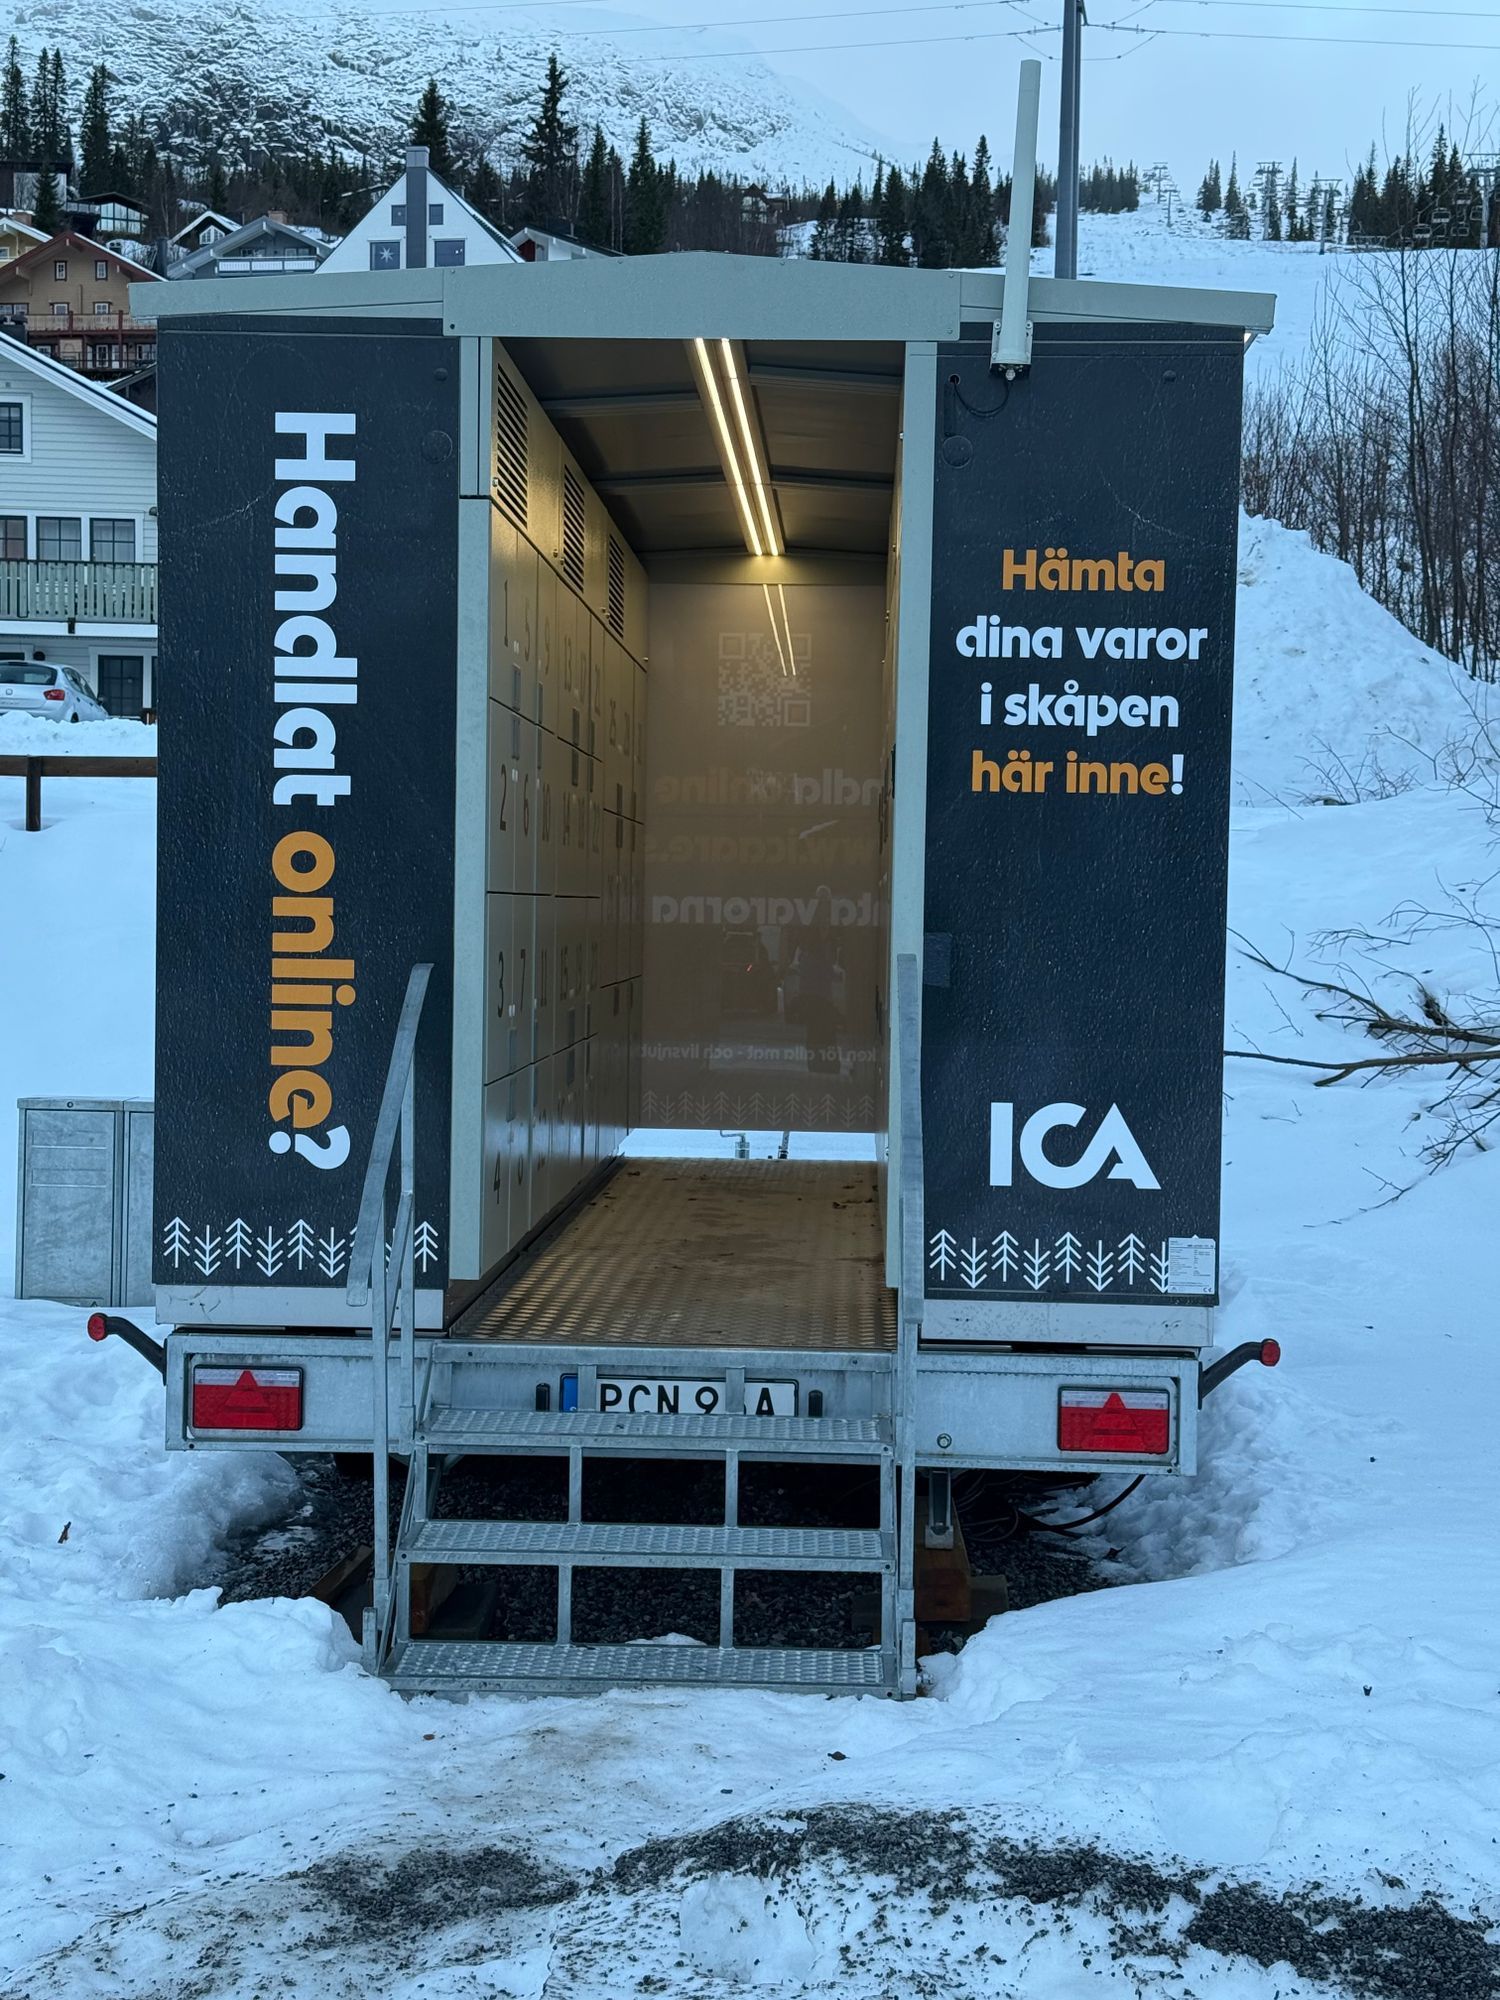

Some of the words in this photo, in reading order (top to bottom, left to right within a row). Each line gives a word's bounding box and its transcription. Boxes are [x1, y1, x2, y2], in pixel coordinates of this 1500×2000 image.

[1002, 547, 1165, 592] Hämta
[273, 412, 358, 806] Handlat
[524, 598, 531, 662] 5
[955, 615, 1063, 659] dina
[1075, 626, 1208, 660] varor
[545, 616, 551, 676] 9
[980, 682, 992, 725] i
[1003, 679, 1179, 736] skåpen
[499, 763, 507, 831] 2
[971, 750, 1054, 793] här
[1065, 750, 1184, 796] inne!
[523, 773, 529, 838] 6
[269, 831, 356, 1170] online?
[497, 951, 504, 1018] 3
[520, 949, 526, 1014] 7
[541, 951, 547, 1007] 11
[989, 1102, 1162, 1190] ICA
[494, 1151, 501, 1205] 4
[695, 1386, 775, 1416] 9A
